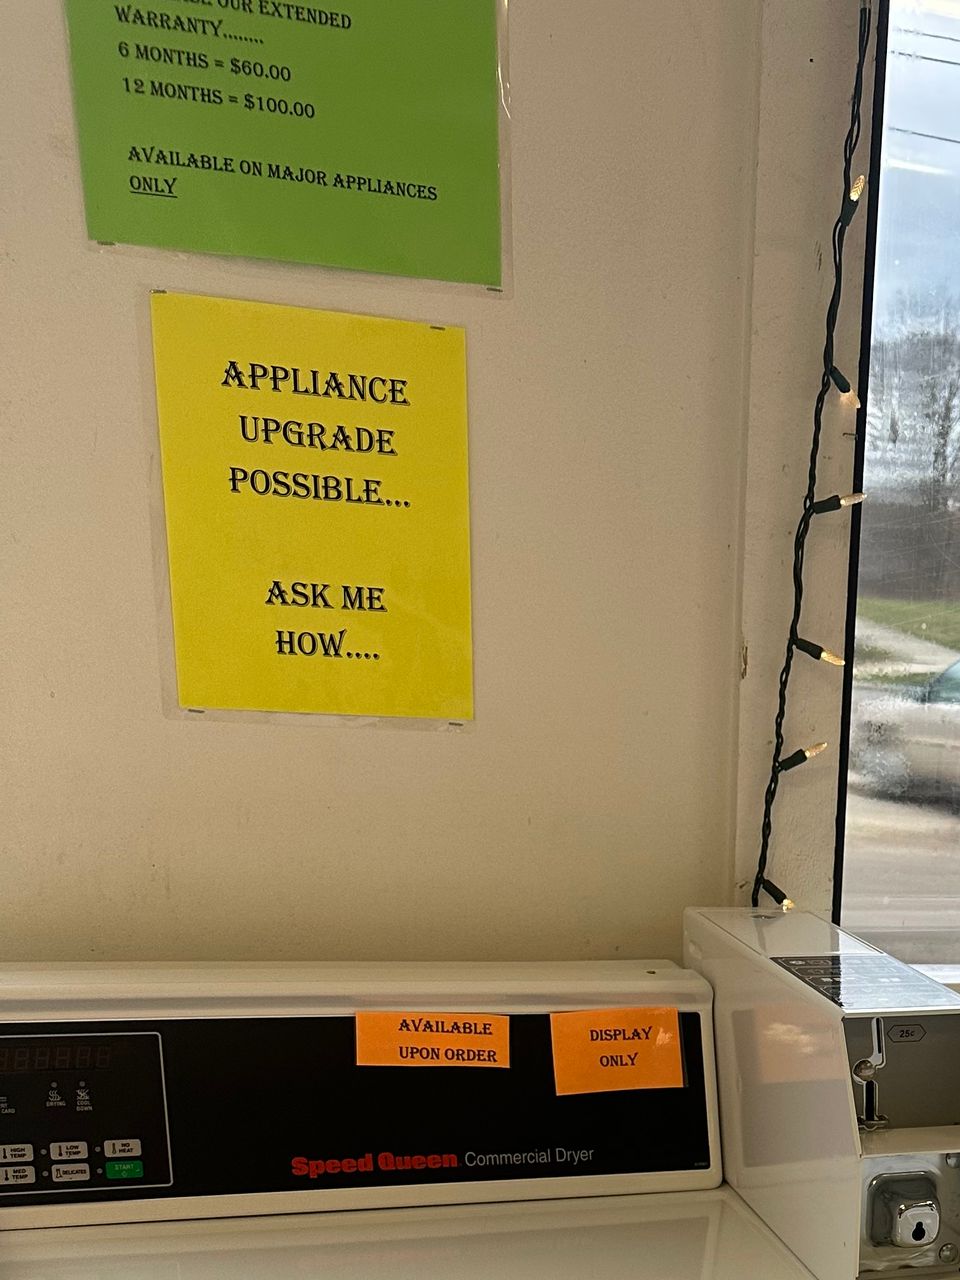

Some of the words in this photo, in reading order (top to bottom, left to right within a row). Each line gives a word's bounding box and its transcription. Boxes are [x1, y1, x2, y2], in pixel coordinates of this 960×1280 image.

[259, 0, 352, 29] EXTENDED
[118, 42, 129, 58] 6
[135, 44, 208, 69] MONTHS
[215, 59, 224, 68] =
[230, 58, 291, 82] $60.00
[122, 77, 145, 94] 12
[150, 81, 223, 105] MONTHS
[229, 95, 238, 104] =
[244, 93, 315, 118] $100.00
[128, 146, 235, 173] AVAILABLE
[240, 160, 262, 177] ON
[267, 163, 328, 187] MAJOR
[332, 173, 438, 201] APPLIANCES
[129, 175, 178, 196] ONLY
[221, 360, 411, 406] APPLIANCE
[239, 415, 398, 456] UPGRADE
[229, 466, 411, 508] POSSIBLE...
[265, 580, 332, 609] ASK
[341, 585, 387, 612] ME
[275, 628, 380, 660] HOW....
[398, 1018, 493, 1036] AVAILABLE
[589, 1026, 653, 1042] DISPLAY
[399, 1046, 440, 1060] UPON
[444, 1048, 498, 1063] ORDER
[600, 1052, 639, 1067] ONLY
[292, 1153, 374, 1178] Speed
[378, 1151, 458, 1171] Queen
[464, 1148, 551, 1167] Commercial
[555, 1147, 594, 1166] Dryer
